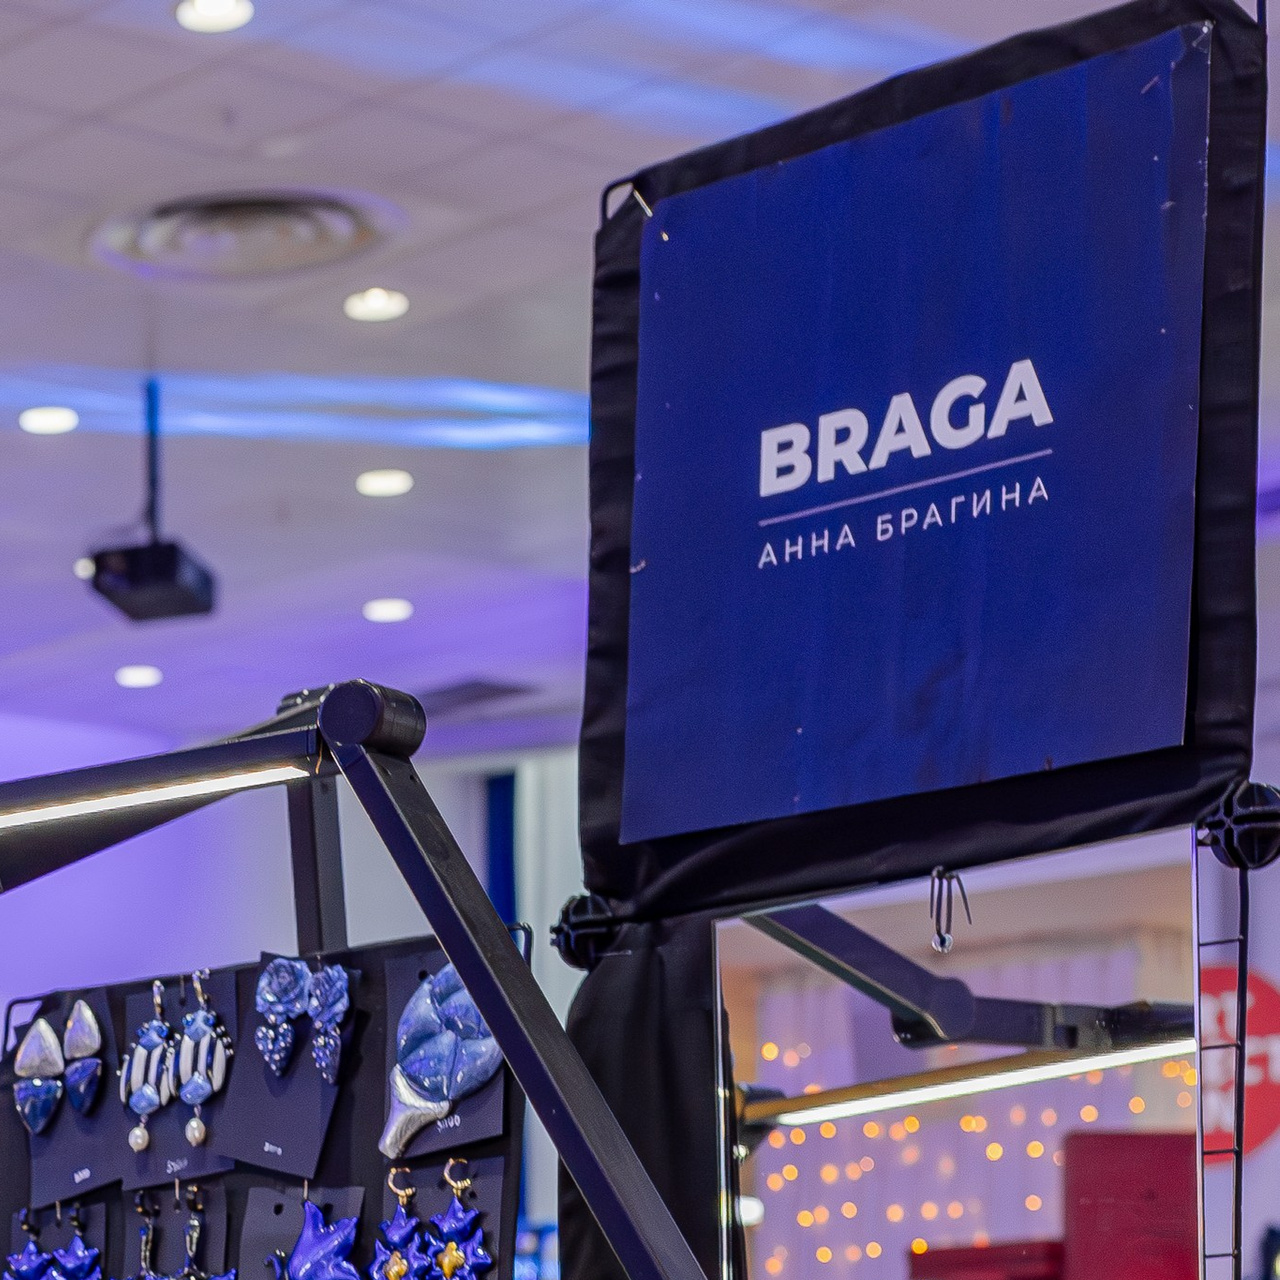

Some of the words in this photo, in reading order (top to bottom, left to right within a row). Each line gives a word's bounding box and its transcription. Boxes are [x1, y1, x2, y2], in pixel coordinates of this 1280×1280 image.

[759, 359, 1053, 498] BRAGA
[758, 525, 857, 570] АННА
[876, 477, 1049, 542] БРАГИНА
